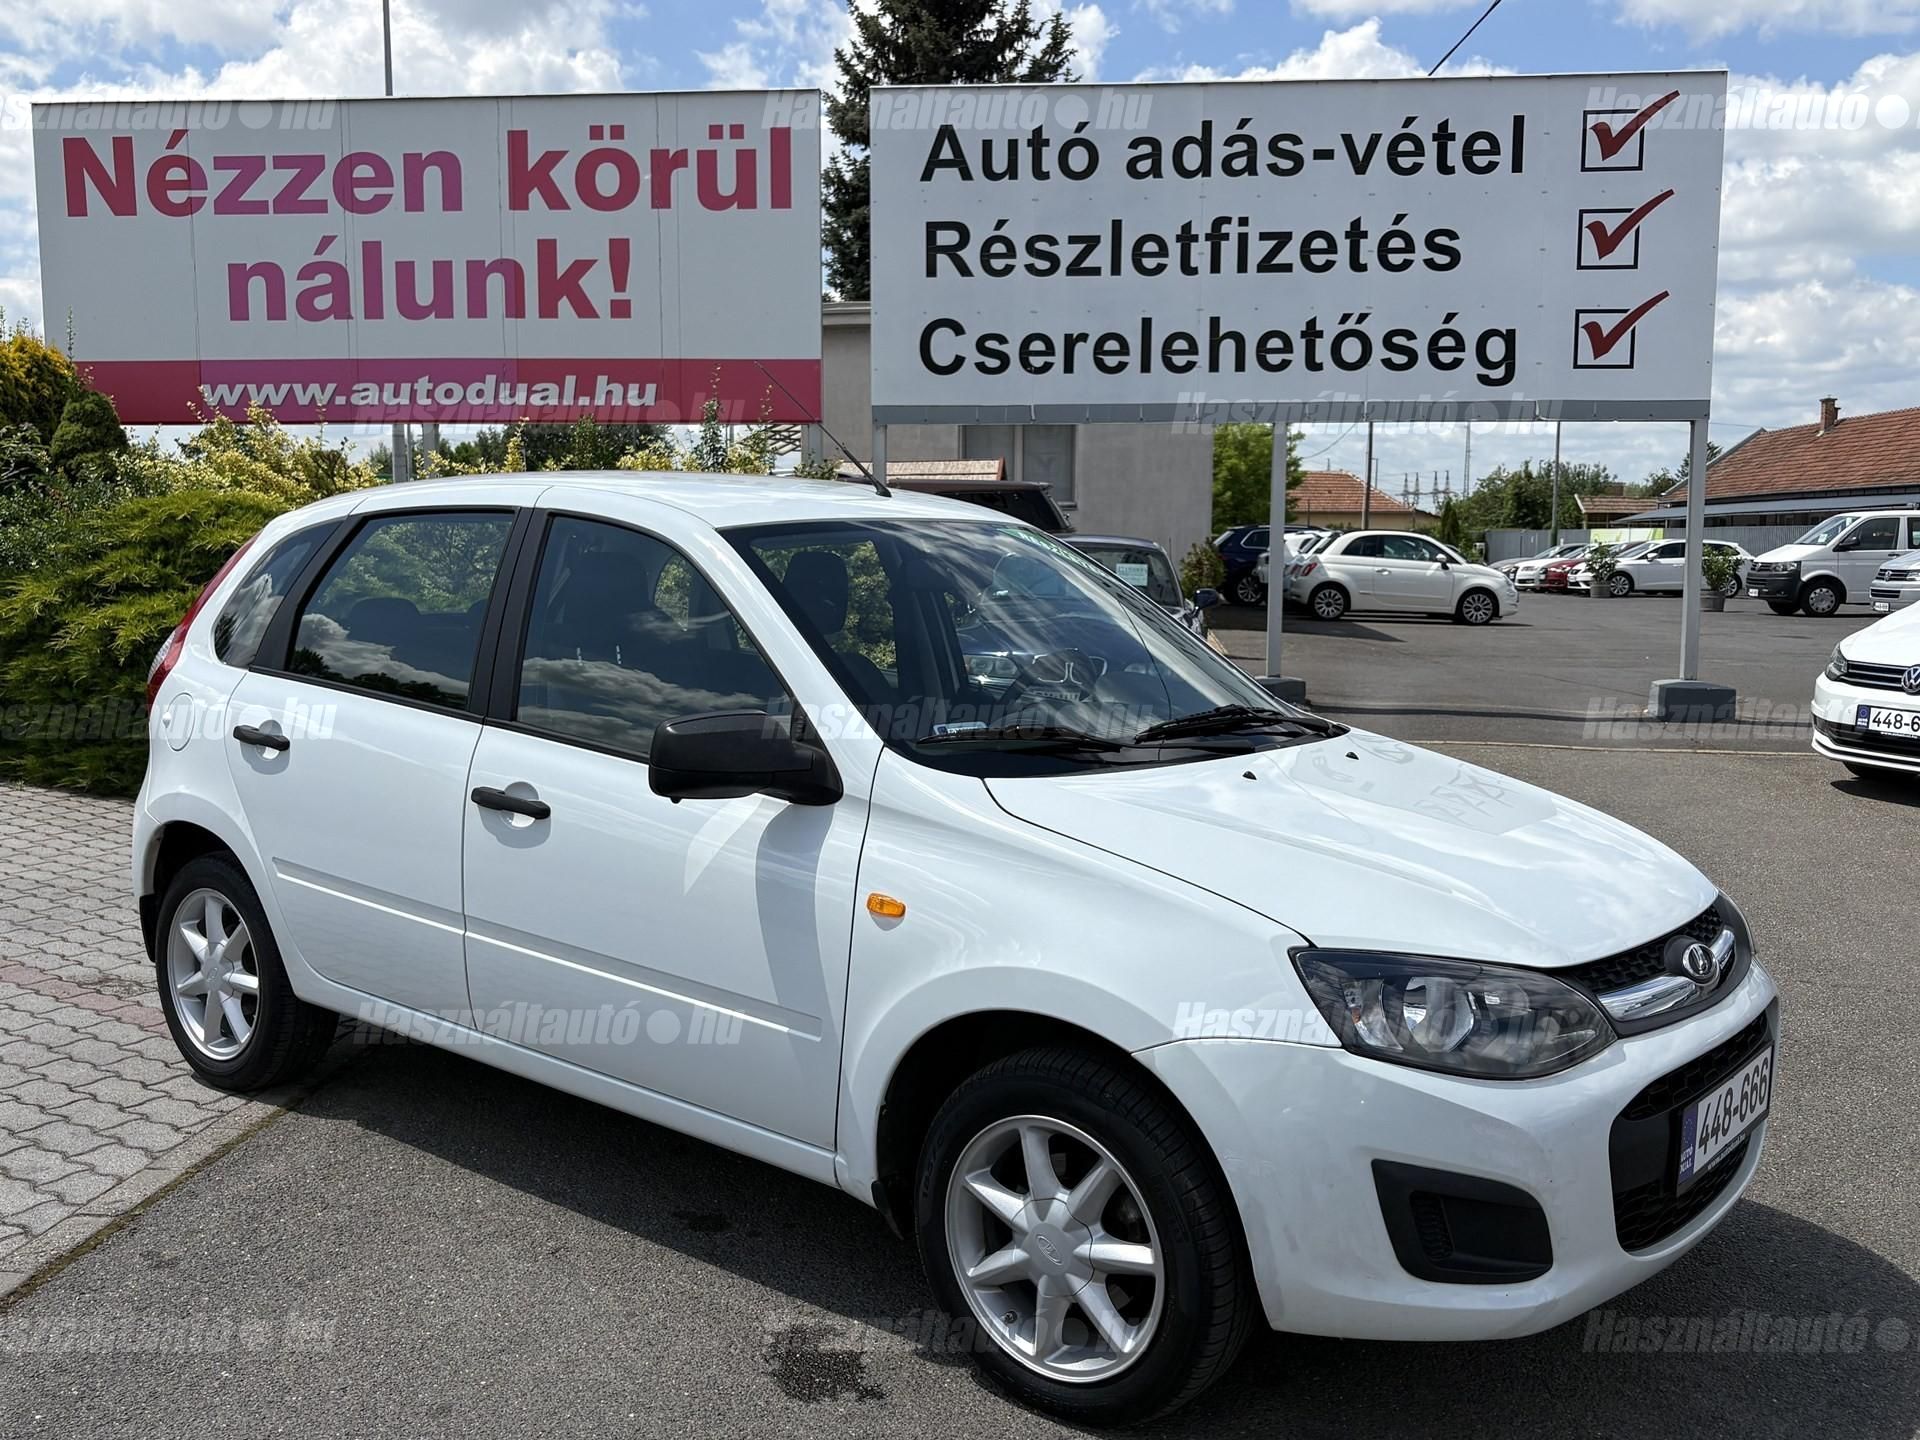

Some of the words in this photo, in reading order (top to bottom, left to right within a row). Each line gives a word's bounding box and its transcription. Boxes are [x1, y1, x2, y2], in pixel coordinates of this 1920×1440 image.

[62, 128, 464, 218] Nézzen
[507, 123, 794, 211] körül
[920, 120, 1100, 182] Autó
[1126, 114, 1526, 180] adás-vétel
[227, 235, 634, 322] nálunk!
[925, 214, 1463, 278] Részletfizetés
[918, 312, 1519, 387] Cserelehetőség
[198, 372, 658, 408] www.autodual.hu
[1698, 1057, 1769, 1156] 448-666
